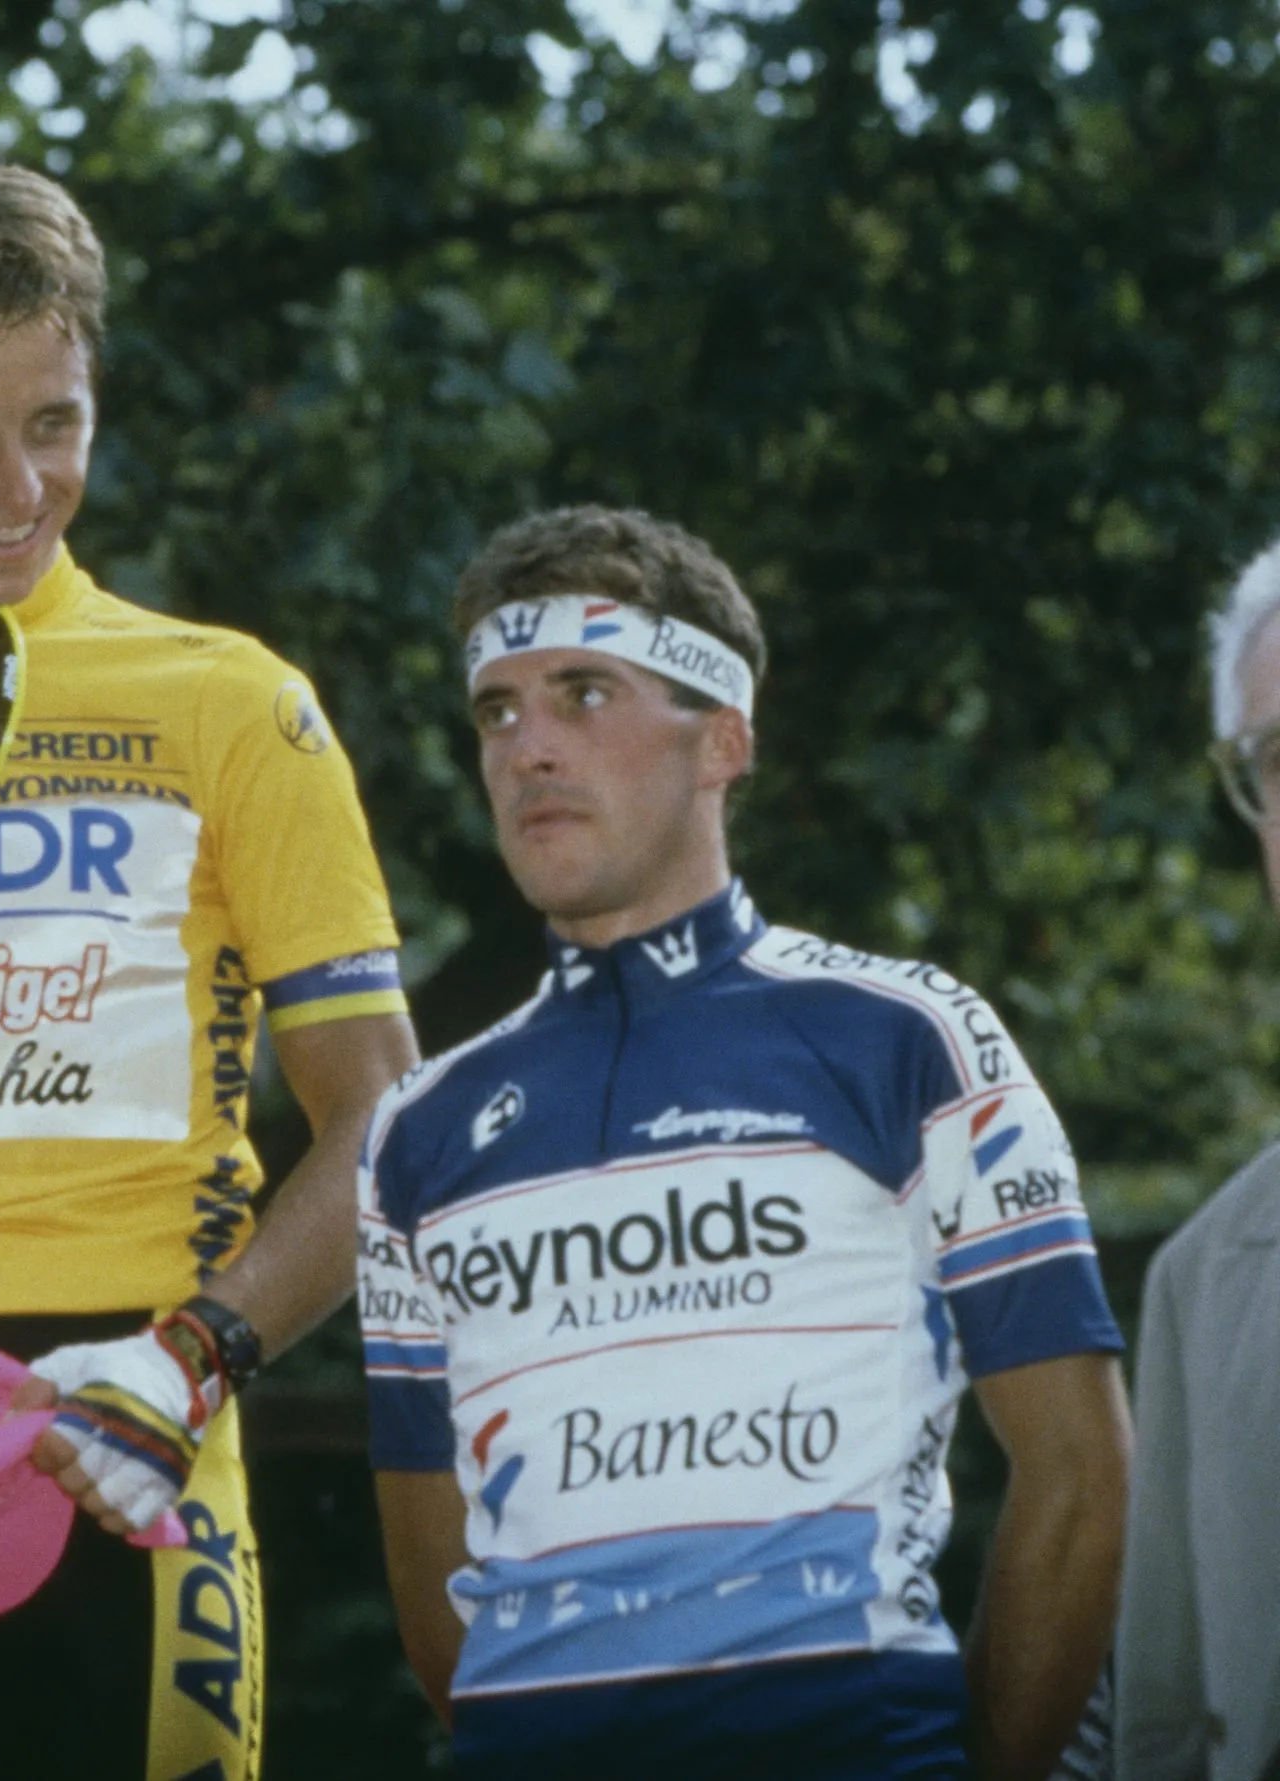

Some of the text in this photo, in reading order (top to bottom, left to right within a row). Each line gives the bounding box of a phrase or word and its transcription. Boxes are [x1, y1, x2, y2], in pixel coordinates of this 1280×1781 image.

[9, 731, 159, 763] CREDIT
[548, 1270, 773, 1336] ALUMINIO
[552, 1380, 839, 1494] Banesto
